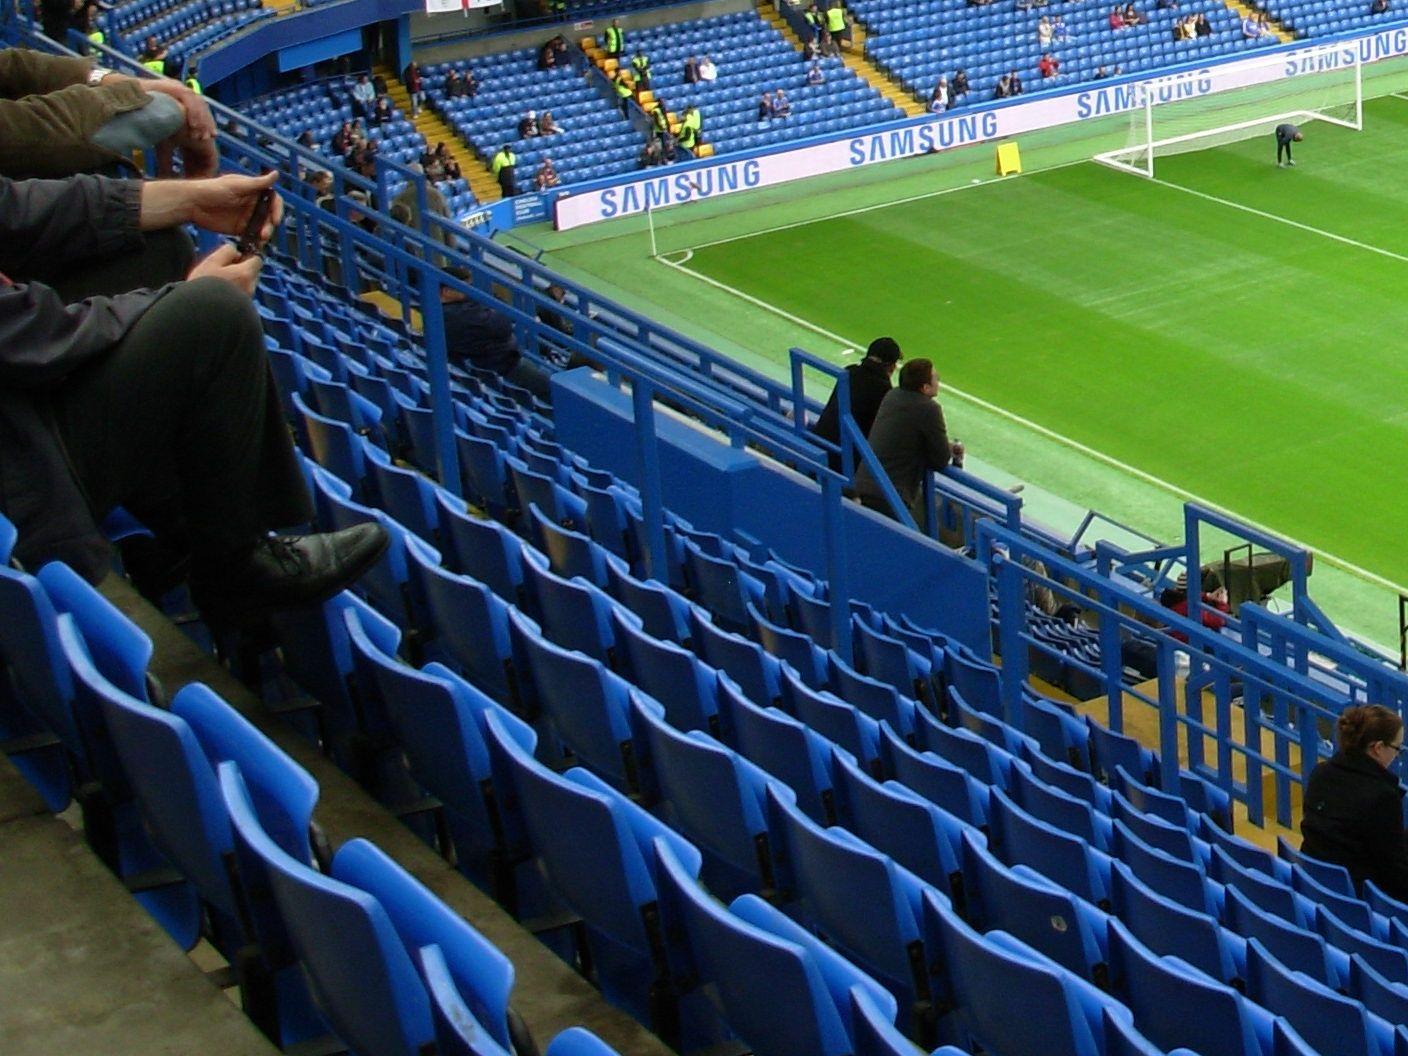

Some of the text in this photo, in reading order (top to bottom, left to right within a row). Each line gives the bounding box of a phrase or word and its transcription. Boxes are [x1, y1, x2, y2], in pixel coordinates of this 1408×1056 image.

[1285, 30, 1407, 76] SAMSUNG
[1077, 69, 1212, 118] SAMSUNG
[850, 112, 998, 166] SAMSUNG
[601, 160, 761, 217] SAMSUNG
